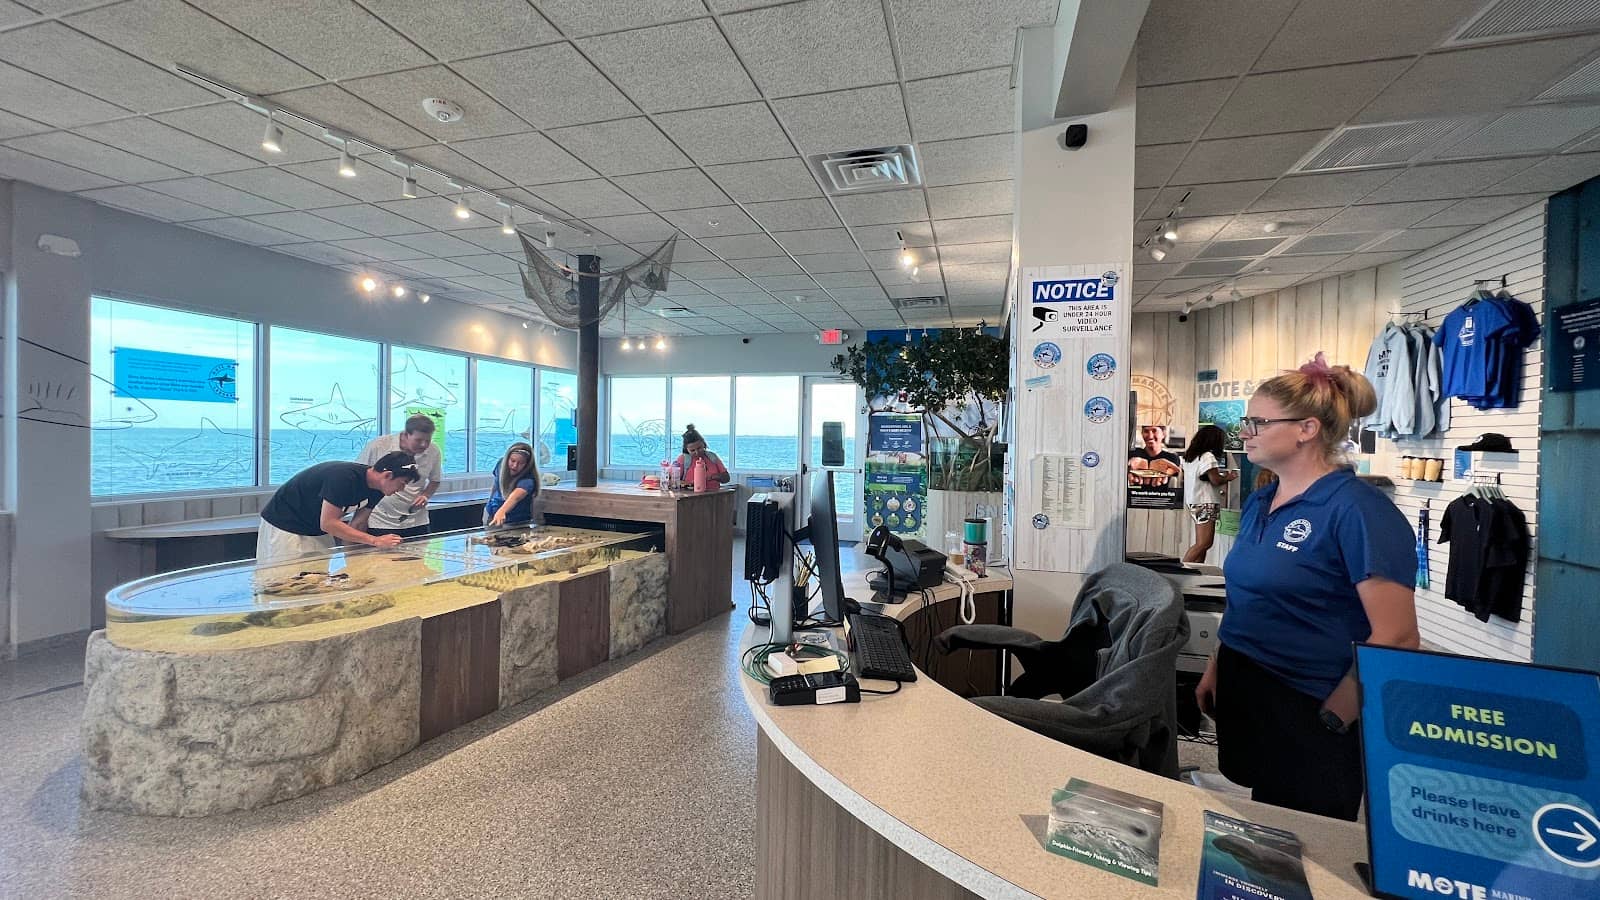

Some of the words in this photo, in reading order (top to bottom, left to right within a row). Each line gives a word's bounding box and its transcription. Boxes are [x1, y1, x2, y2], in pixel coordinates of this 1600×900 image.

[1036, 282, 1108, 299] NOTICE
[1062, 324, 1113, 332] SURVEILLANCE
[1198, 380, 1240, 399] MOTE
[1243, 379, 1256, 396] &
[1276, 541, 1299, 552] STAFF
[1451, 704, 1505, 726] FREE
[1409, 721, 1558, 759] ADMISSION
[1411, 786, 1469, 809] Please
[1472, 798, 1521, 819] leave
[1412, 805, 1470, 828] drinks
[1473, 817, 1517, 838] here
[1118, 860, 1140, 874] Viewing
[1140, 868, 1152, 877] Tips
[1224, 878, 1234, 887] IN
[1407, 869, 1487, 900] MOTE
